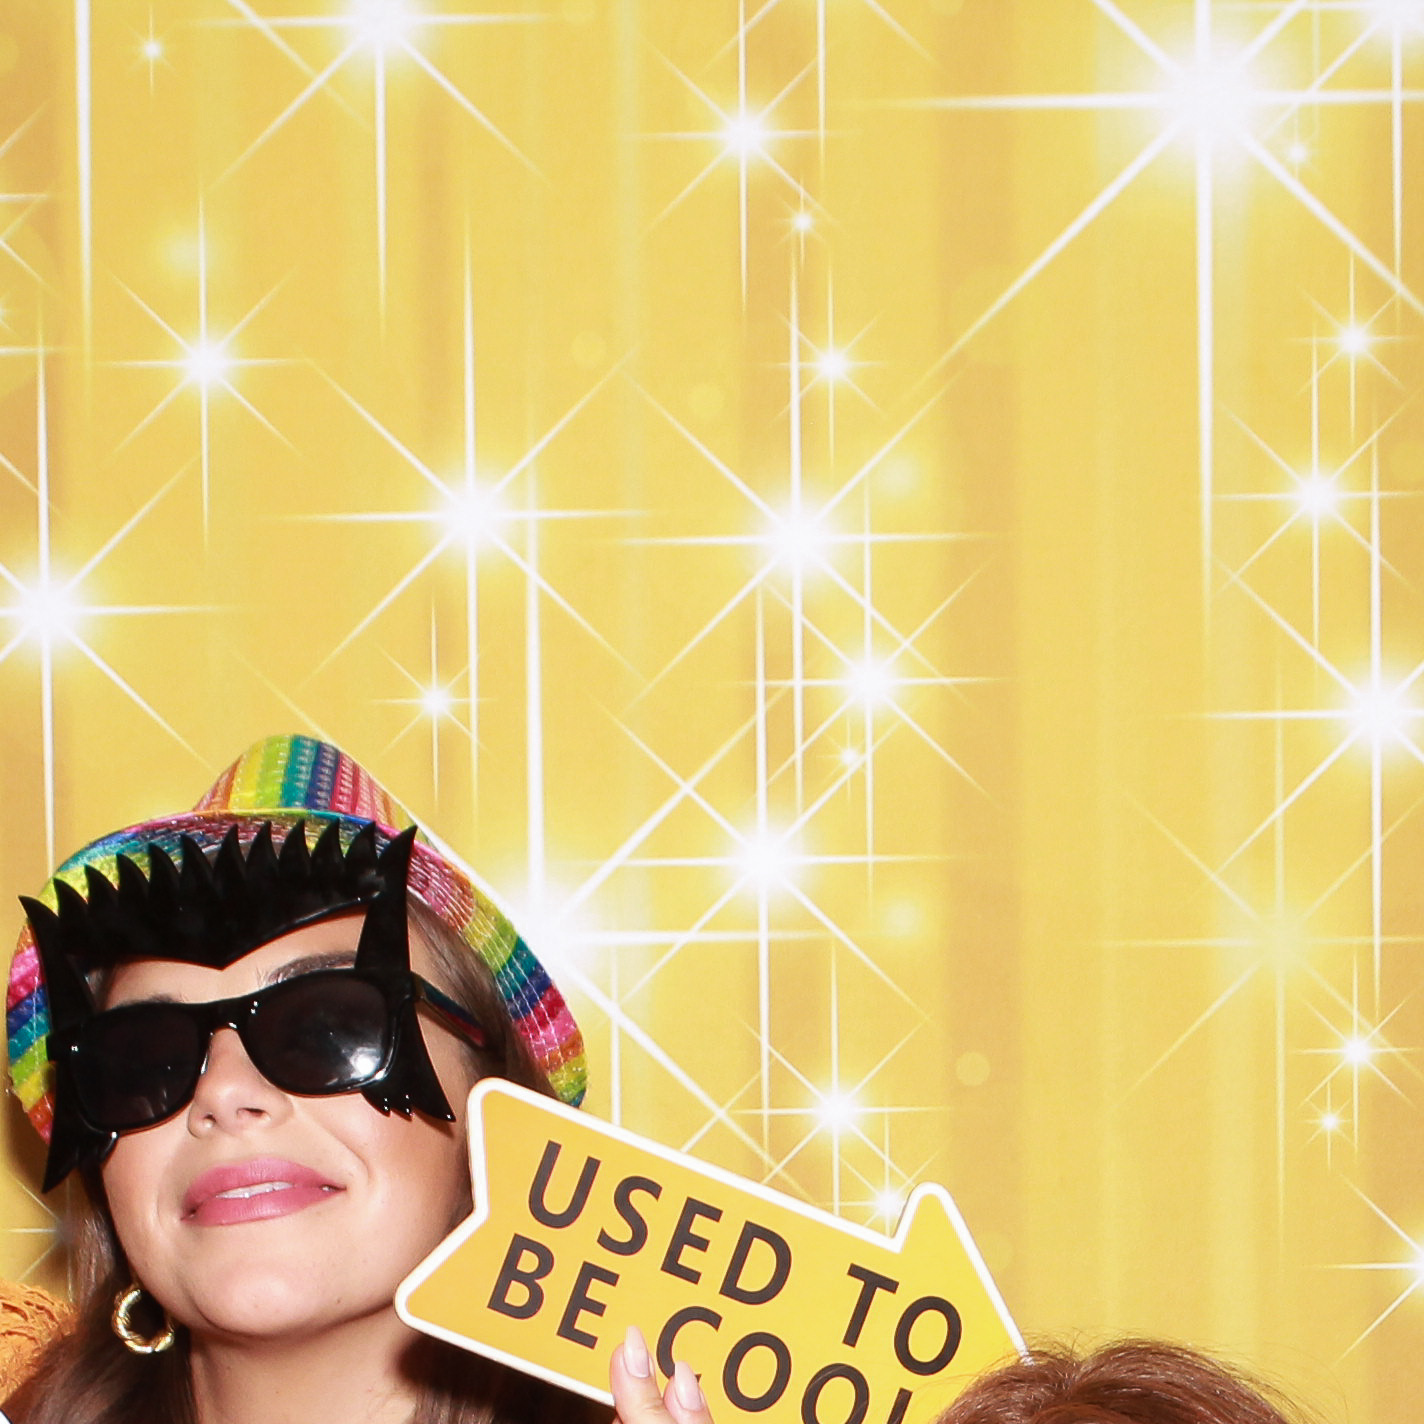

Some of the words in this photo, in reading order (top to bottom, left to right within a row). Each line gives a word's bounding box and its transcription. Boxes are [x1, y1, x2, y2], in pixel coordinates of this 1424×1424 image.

[487, 1233, 621, 1349] BE
[528, 1140, 792, 1306] USED
[844, 1263, 962, 1376] TO
